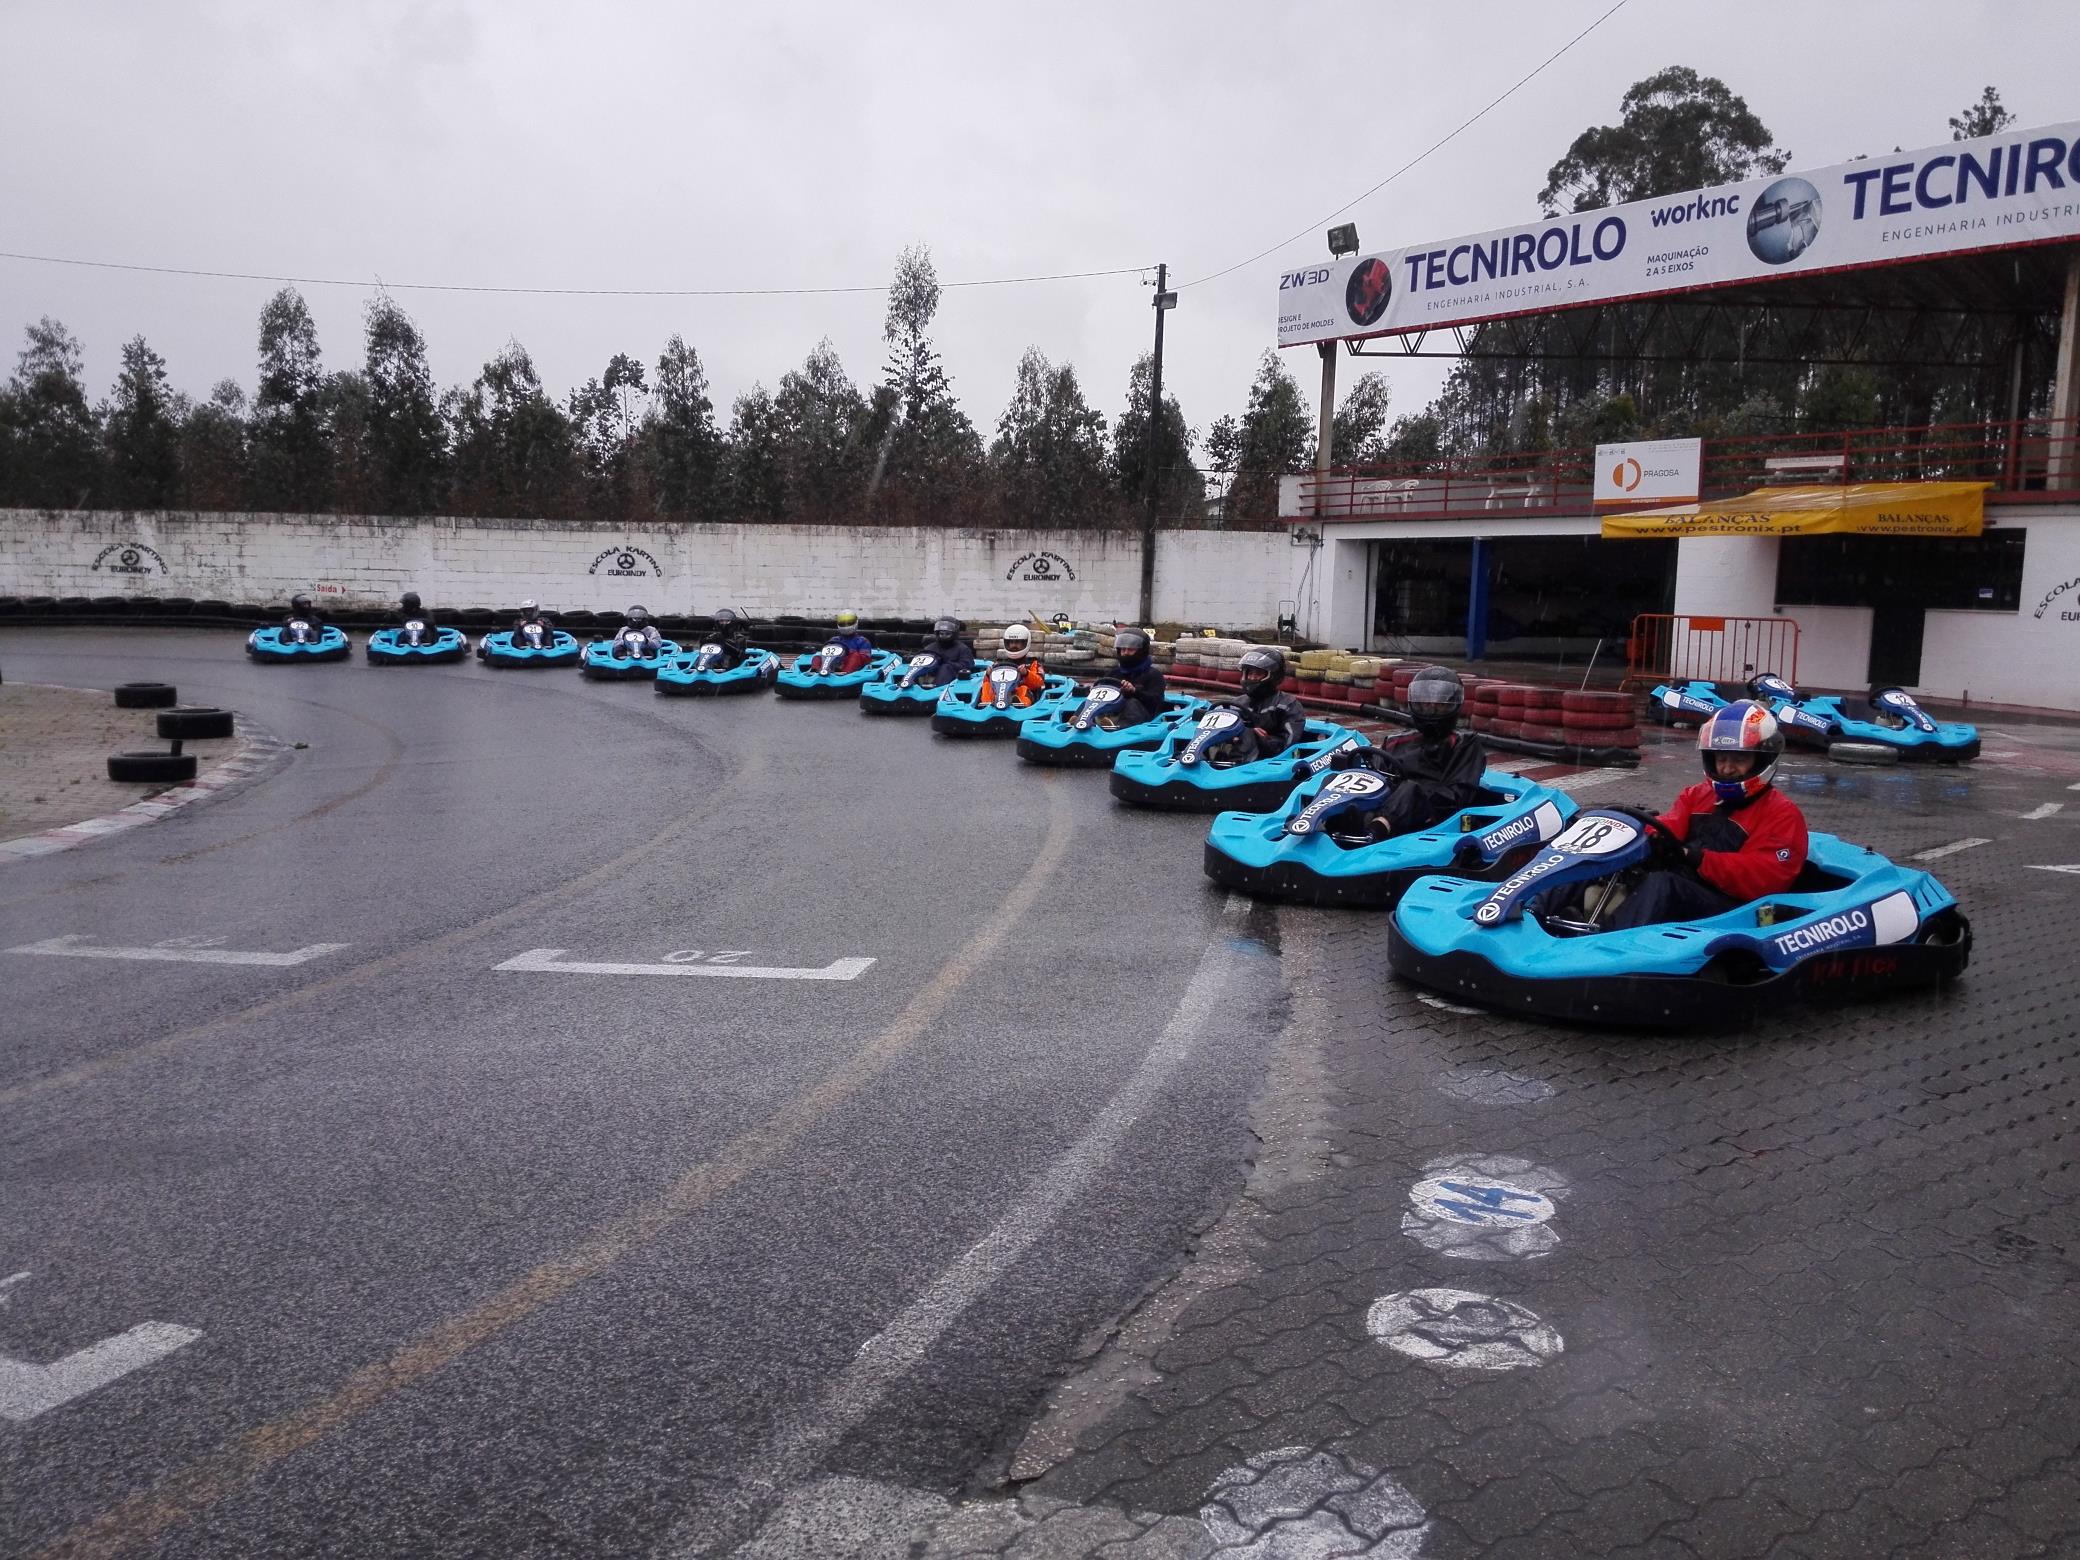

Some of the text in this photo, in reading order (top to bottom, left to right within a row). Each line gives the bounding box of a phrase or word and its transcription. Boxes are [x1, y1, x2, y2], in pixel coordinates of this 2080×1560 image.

[1651, 194, 1740, 228] worknc
[1882, 217, 1987, 242] ENGENHARIA
[1404, 216, 1627, 293] TECNIROLO
[1647, 245, 1709, 265] MAQUINAÇÃO
[1646, 262, 1694, 277] 2 A 5 EIXOS
[1427, 278, 1590, 311] ENGENHARIA INDUSTRIAL, S.A.
[1310, 318, 1335, 329] MOLDES
[1643, 469, 1679, 477] PRAGOSA
[1878, 513, 1950, 523] BALANÇAS
[1635, 525, 1802, 534] www.pestronix.pt
[589, 546, 662, 577] ESCOLA KARTING
[1006, 551, 1076, 581] ESCOLA KARTING
[825, 648, 836, 656] 32
[1000, 670, 1005, 680] 1
[1095, 690, 1108, 699] 13
[1206, 714, 1220, 727] 11
[1334, 775, 1373, 791] 25
[1482, 816, 1534, 851] TECNIROLO
[1571, 822, 1613, 848] 18
[1491, 854, 1564, 901] TECNIROLO
[1774, 911, 1867, 955] TECNIROLO
